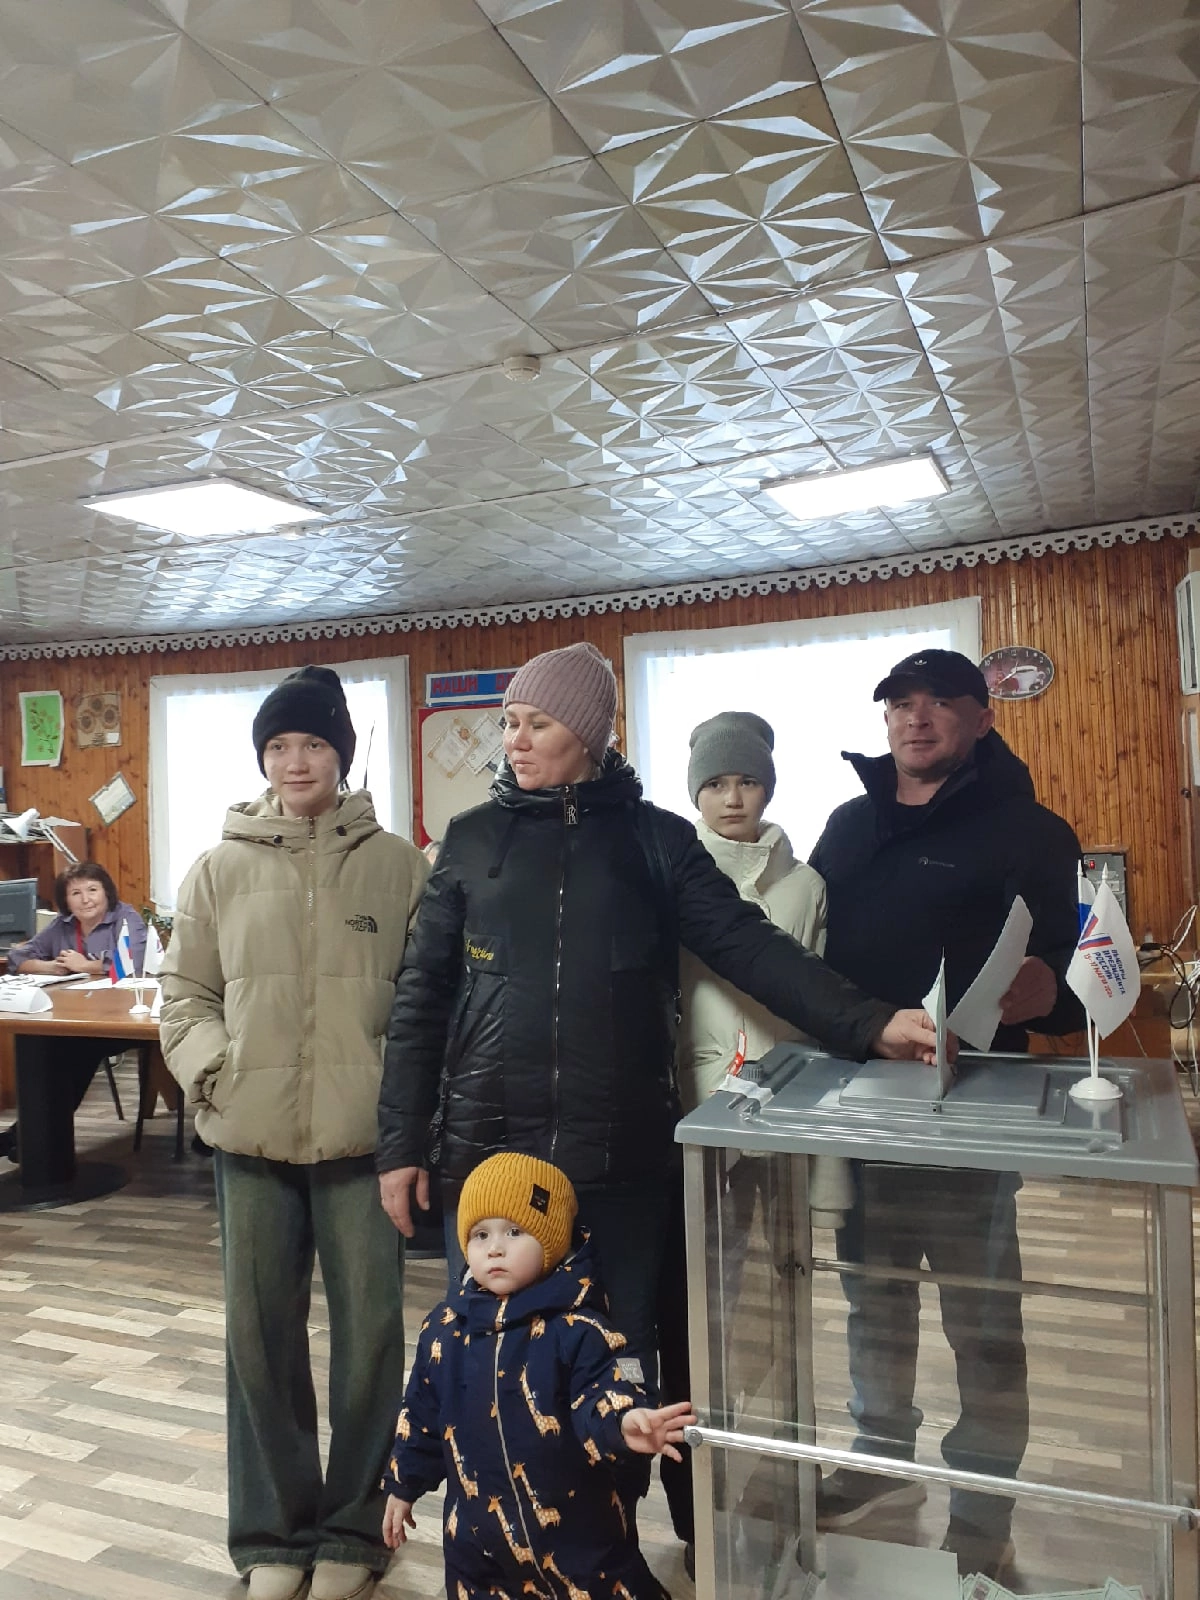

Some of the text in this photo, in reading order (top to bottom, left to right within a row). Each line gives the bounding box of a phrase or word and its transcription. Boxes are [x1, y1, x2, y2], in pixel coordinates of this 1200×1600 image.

[432, 674, 478, 695] НАШИ
[1092, 951, 1112, 980] РОССИИ
[1102, 949, 1126, 995] ПРЕЗИДЕНТА
